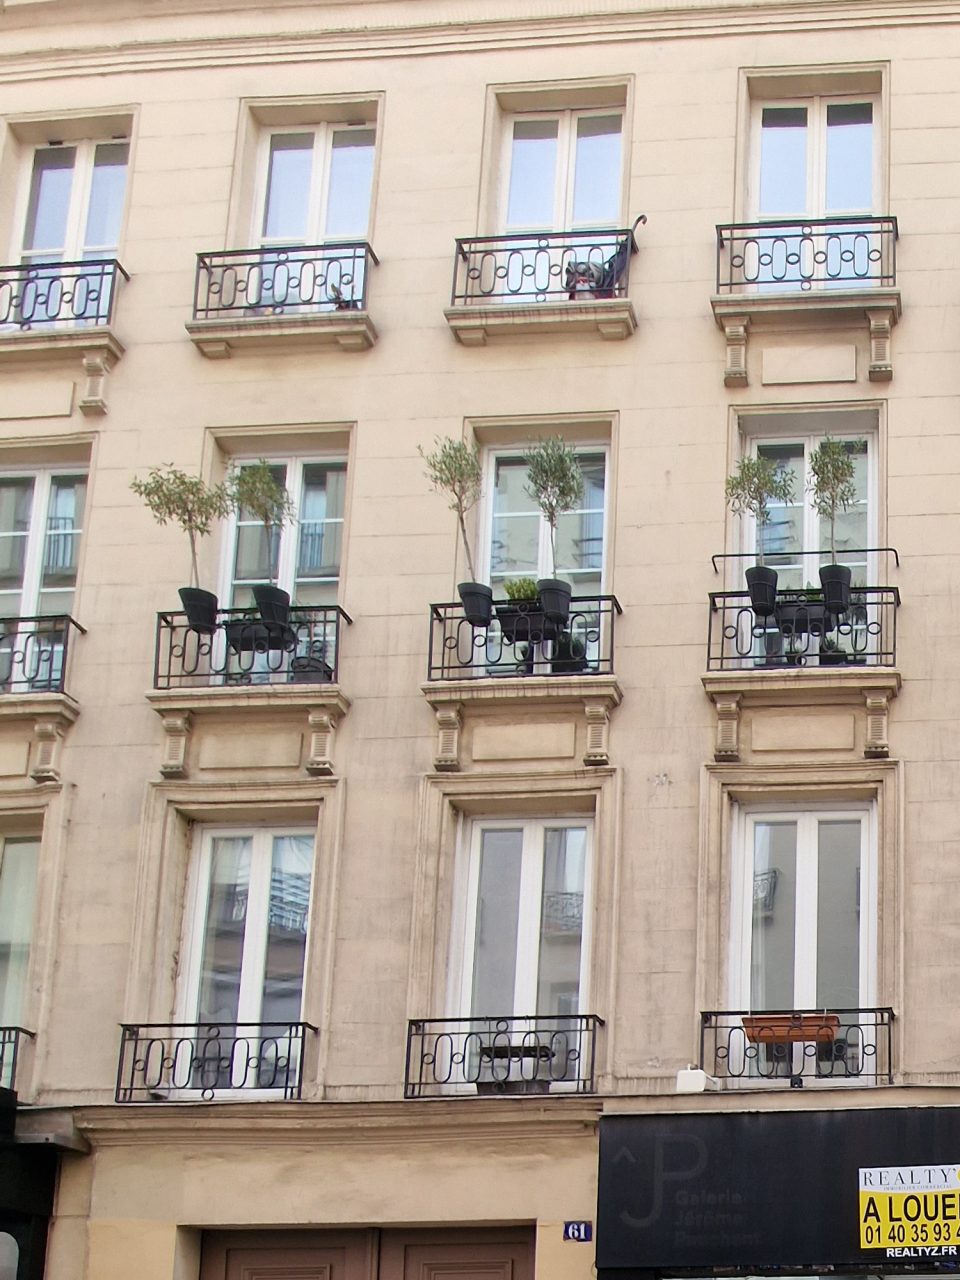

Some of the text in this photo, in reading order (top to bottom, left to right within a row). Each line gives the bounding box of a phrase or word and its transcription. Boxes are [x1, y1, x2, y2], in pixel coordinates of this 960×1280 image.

[863, 1197, 881, 1223] A
[568, 1223, 586, 1239] 61
[865, 1225, 881, 1244] 01
[888, 1224, 905, 1243] 40
[911, 1224, 928, 1242] 35
[933, 1223, 951, 1241] 93
[886, 1246, 957, 1258] REALTYZ.FR
